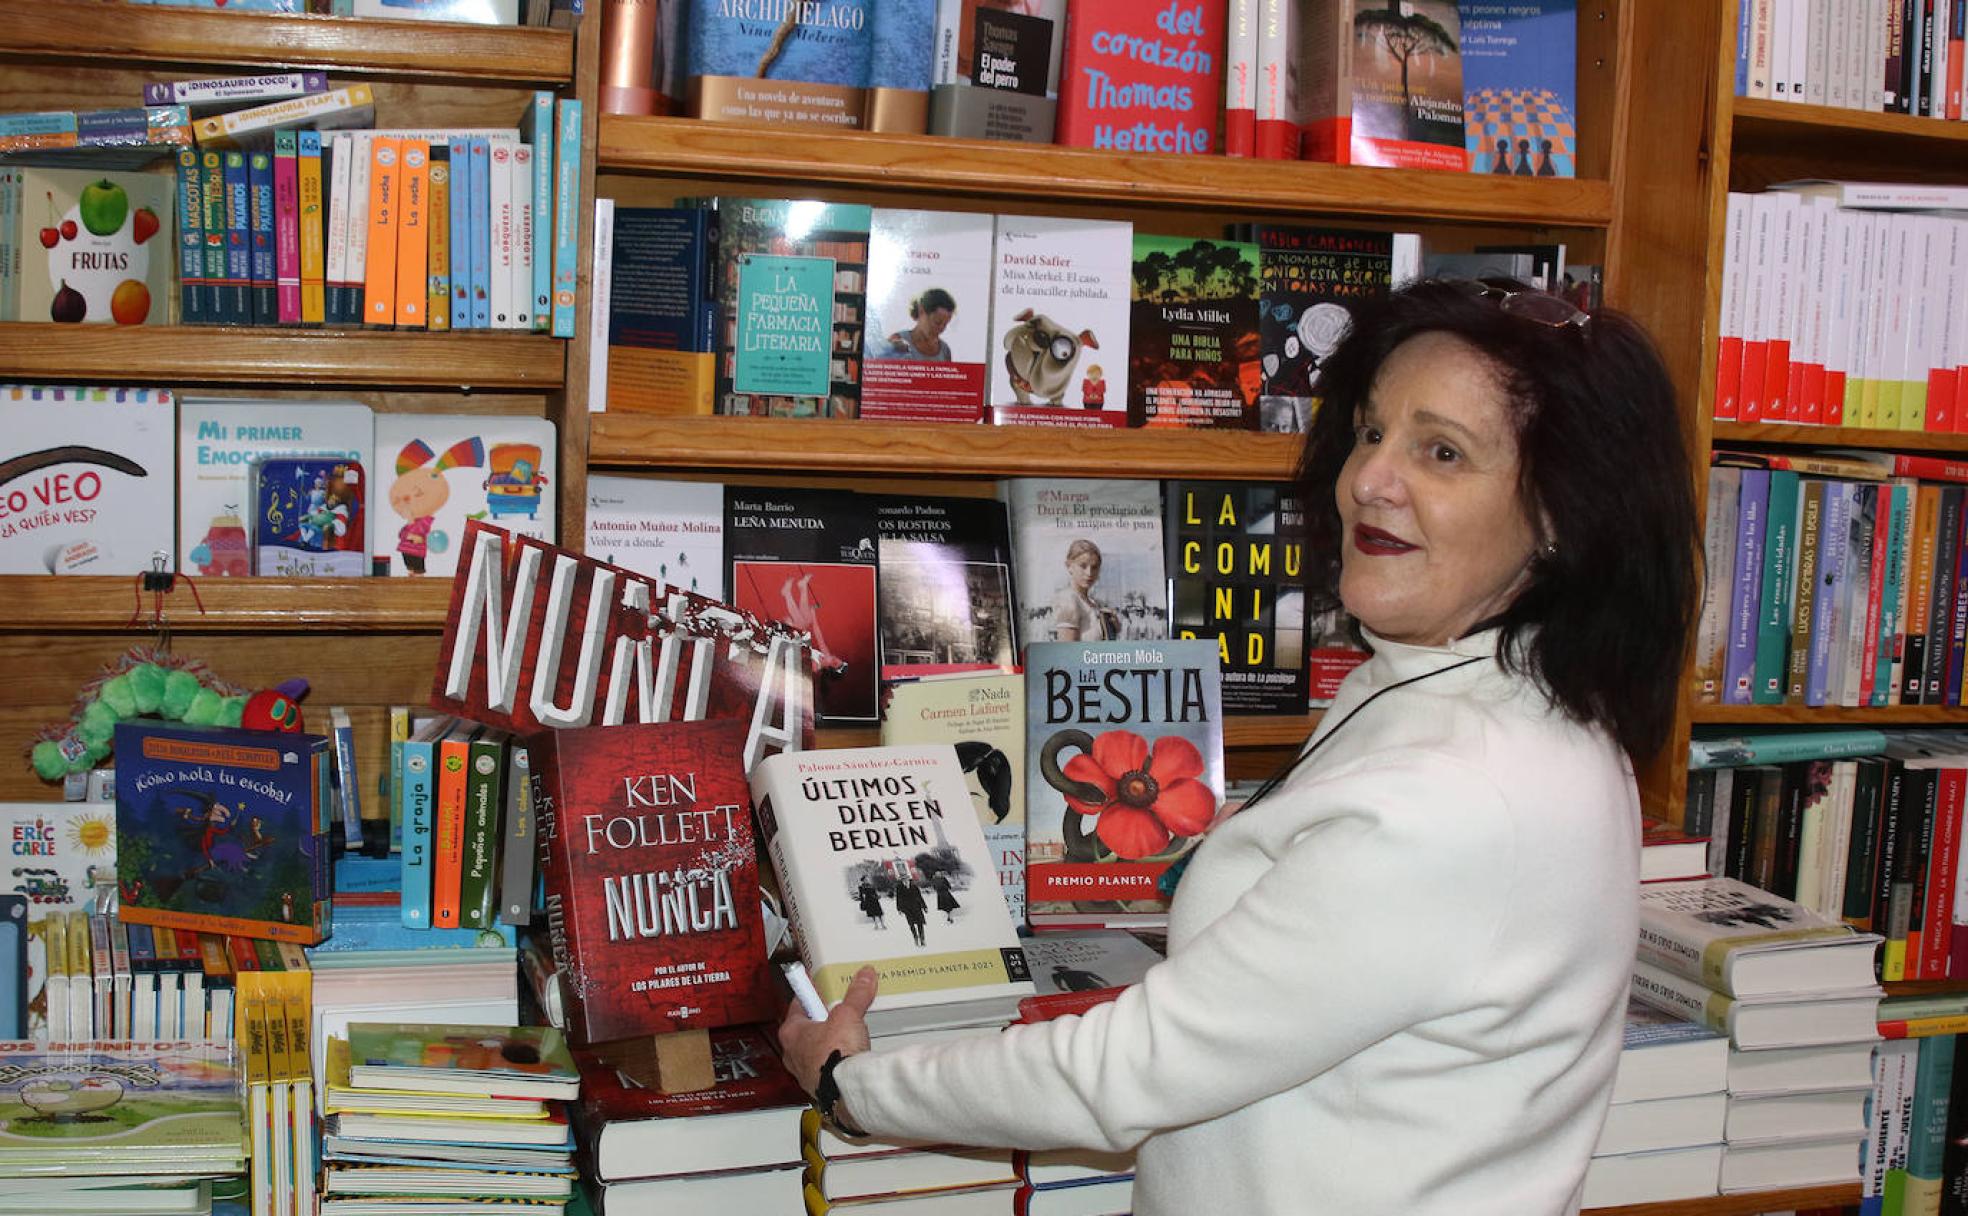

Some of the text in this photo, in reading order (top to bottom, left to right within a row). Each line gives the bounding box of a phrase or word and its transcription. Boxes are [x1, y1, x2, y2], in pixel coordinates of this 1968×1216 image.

[1157, 2, 1205, 35] del
[980, 52, 1017, 73] El poder
[1091, 31, 1211, 74] corazón
[189, 76, 290, 91] ¡DINOSAURIO COCO!
[980, 69, 1019, 90] del perro
[1083, 67, 1193, 111] Thomas
[737, 87, 756, 100] Una
[758, 89, 787, 103] novela
[788, 91, 800, 104] de
[1410, 95, 1462, 113] Alejandro
[1417, 108, 1463, 124] Palomas
[186, 168, 201, 229] MASCOTAS
[378, 175, 390, 225] La noche
[406, 176, 420, 227] La noche
[502, 203, 511, 266] LA ORQUESTA
[523, 204, 532, 267] LA ORQUESTA
[72, 252, 129, 271] FRUTAS
[1003, 253, 1071, 267] David Safier
[775, 274, 797, 292] LA
[1003, 269, 1100, 284] Miss Merkel. El caso
[1002, 284, 1109, 300] de la canciller jubilada
[751, 292, 819, 314] PEQUEÑA
[747, 312, 822, 333] FARMACIA
[1162, 307, 1231, 324] Lydia Millet
[744, 333, 822, 352] LITERARIA
[1171, 333, 1221, 348] UNA BIBLIA
[1169, 347, 1223, 363] PARA NIÑOS
[34, 471, 102, 506] VEO
[1050, 490, 1090, 502] Marga
[63, 509, 97, 523] VES?
[734, 501, 795, 512] Marta Barrio
[1037, 503, 1154, 518] Durá El prodigio de
[1186, 492, 1237, 527] LA
[591, 519, 721, 534] Antonio Muñoz Molina
[734, 515, 825, 529] LEÑA MENUDA
[878, 520, 951, 531] OS ROSTROS
[1055, 518, 1155, 531] las migas de pan
[590, 536, 665, 548] Volver a dónde
[1184, 541, 1302, 577] COMU
[1741, 572, 1752, 582] la
[1769, 608, 1779, 625] Las
[1774, 525, 1787, 575] olvidadas
[1215, 587, 1261, 622] NI
[1739, 594, 1750, 630] mujeres
[1954, 591, 1968, 639] MUJERES
[1736, 632, 1747, 648] Las
[1083, 649, 1164, 664] Carmen Mola
[1079, 669, 1097, 683] LA
[980, 688, 1011, 701] Nada
[1044, 668, 1209, 724] BESTIA
[920, 707, 967, 721] Carmen
[799, 757, 940, 773] Paloma Sánchez-Garnica
[178, 766, 215, 783] mola
[218, 769, 236, 786] tu
[240, 777, 294, 805] escoba!
[624, 773, 698, 808] KEN
[801, 775, 917, 801] ÚLTIMOS
[1946, 780, 1956, 800] NAZI
[1922, 782, 1934, 815] BRAND
[542, 796, 558, 840] KEN
[838, 799, 943, 825] DÍAS EN
[408, 782, 429, 867] La granja
[471, 783, 488, 878] Pequeños animales
[583, 804, 741, 855] FOLLETT
[1943, 803, 1954, 843] CONDESA
[828, 823, 929, 852] BERLÍN
[12, 841, 57, 856] CARLE
[1048, 875, 1152, 886] PREMIO PLANETA
[1939, 879, 1947, 888] LA
[604, 868, 740, 942] NUNCA
[655, 963, 706, 975] POR EL AUTOR DE
[632, 972, 731, 992] LOS PILARES DE LA TIERRA
[1900, 1096, 1912, 1137] JUEVES
